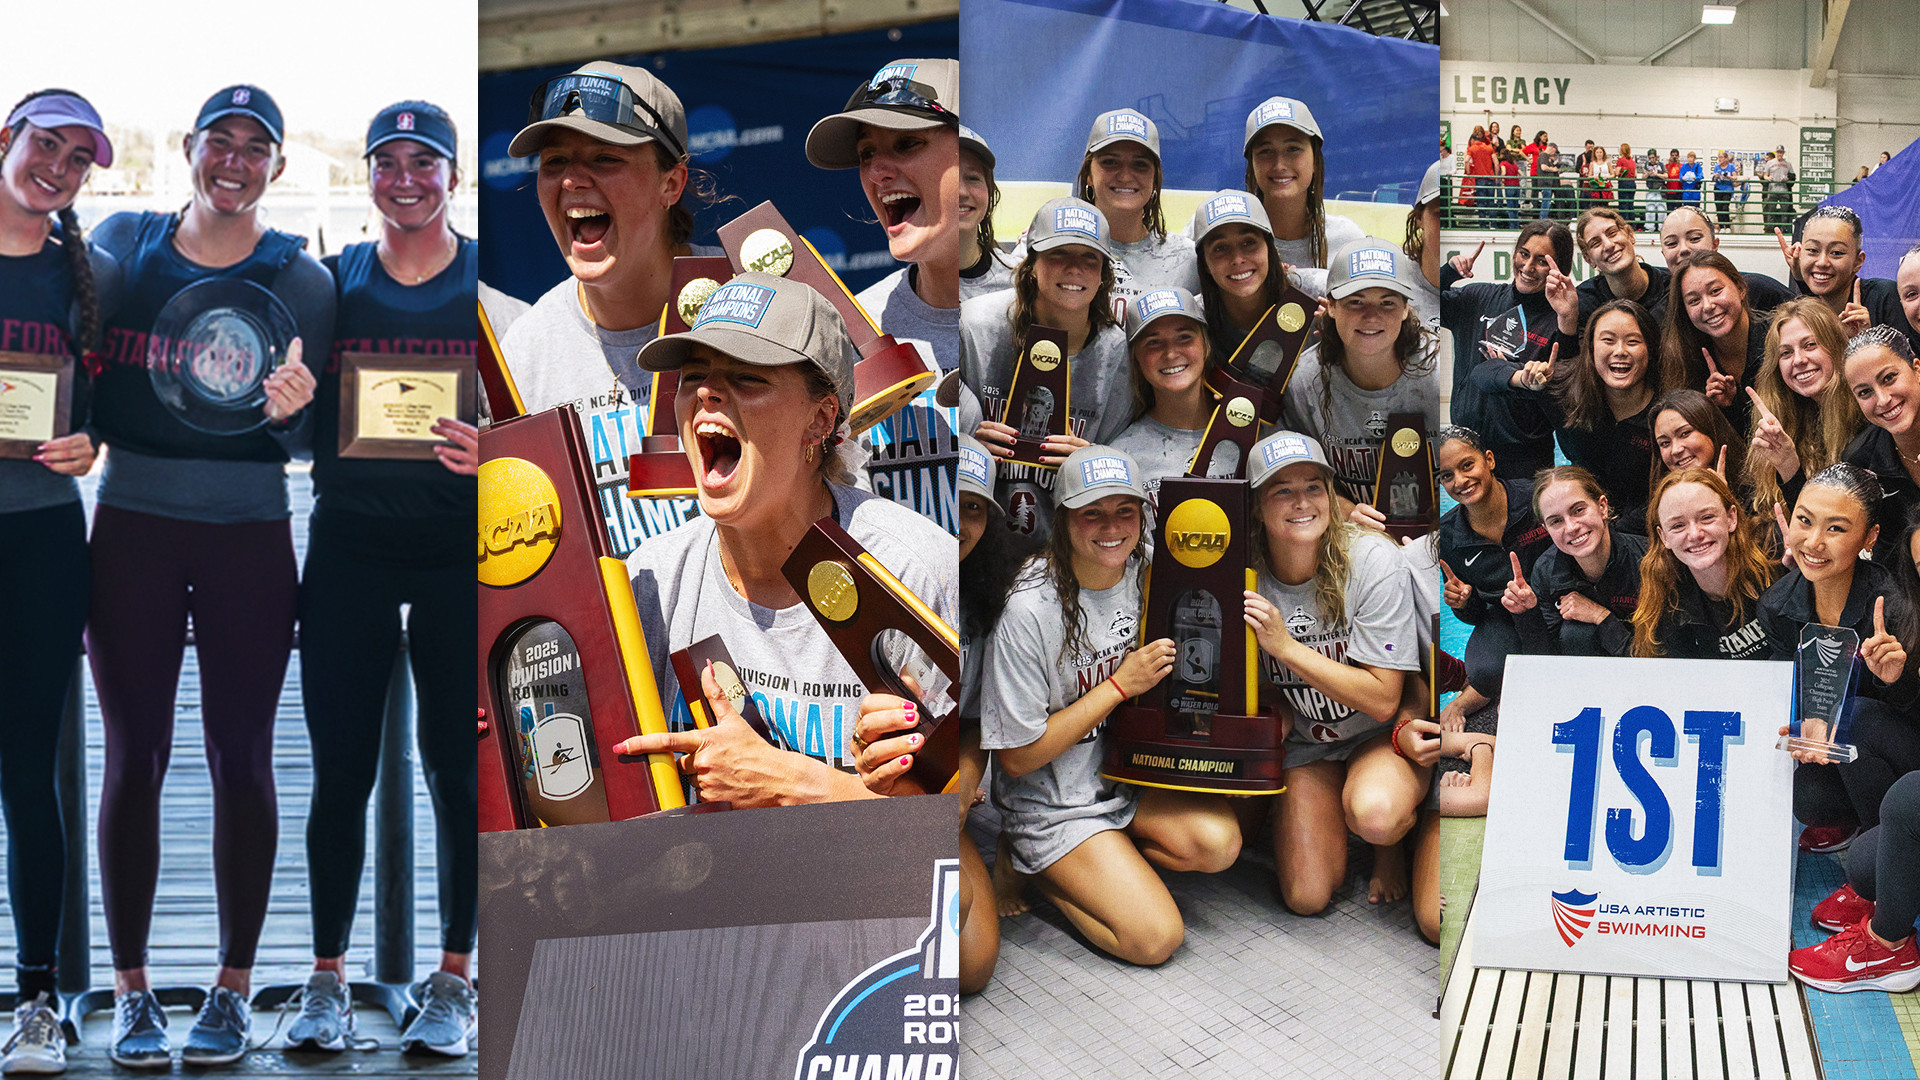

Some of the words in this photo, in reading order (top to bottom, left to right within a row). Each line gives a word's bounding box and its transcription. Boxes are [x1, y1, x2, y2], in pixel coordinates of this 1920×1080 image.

[1454, 75, 1571, 106] LEGACY
[691, 126, 784, 151] NCAA.com
[1214, 195, 1245, 208] NATIONAL
[1064, 208, 1096, 224] NATIONAL
[1064, 217, 1097, 235] CHAMPIONS
[749, 241, 793, 272] NCAA
[1360, 250, 1393, 263] NATIONAL
[1360, 260, 1393, 273] CHAMPIONS
[710, 285, 765, 305] NATIONAL
[701, 301, 759, 321] CHAMPIONS
[1032, 353, 1059, 366] NCAA
[982, 385, 1000, 396] 2025
[1227, 409, 1253, 422] NCAA
[1271, 436, 1306, 450] NATIONAL
[1273, 446, 1309, 460] CHAMPIONS
[1092, 458, 1126, 472] NATIONAL
[1093, 467, 1129, 480] CHAMPIONS
[1170, 530, 1228, 553] NCAA
[526, 639, 559, 663] 2025
[511, 653, 572, 688] DIVISION
[512, 683, 569, 701] ROWING
[803, 682, 862, 698] ROWING
[1809, 688, 1838, 699] Championship
[1180, 700, 1202, 710] WATER
[1202, 702, 1219, 711] POLO
[1132, 753, 1176, 769] NATIONAL
[1178, 758, 1235, 774] CHAMPION
[1552, 705, 1742, 869] 1ST
[1599, 903, 1631, 915] USA
[1634, 905, 1705, 918] ARTISTIC
[1597, 921, 1707, 939] SWIMMING
[904, 993, 959, 1017] 20
[904, 1021, 959, 1044] RO
[806, 1053, 959, 1080] CHAMP
